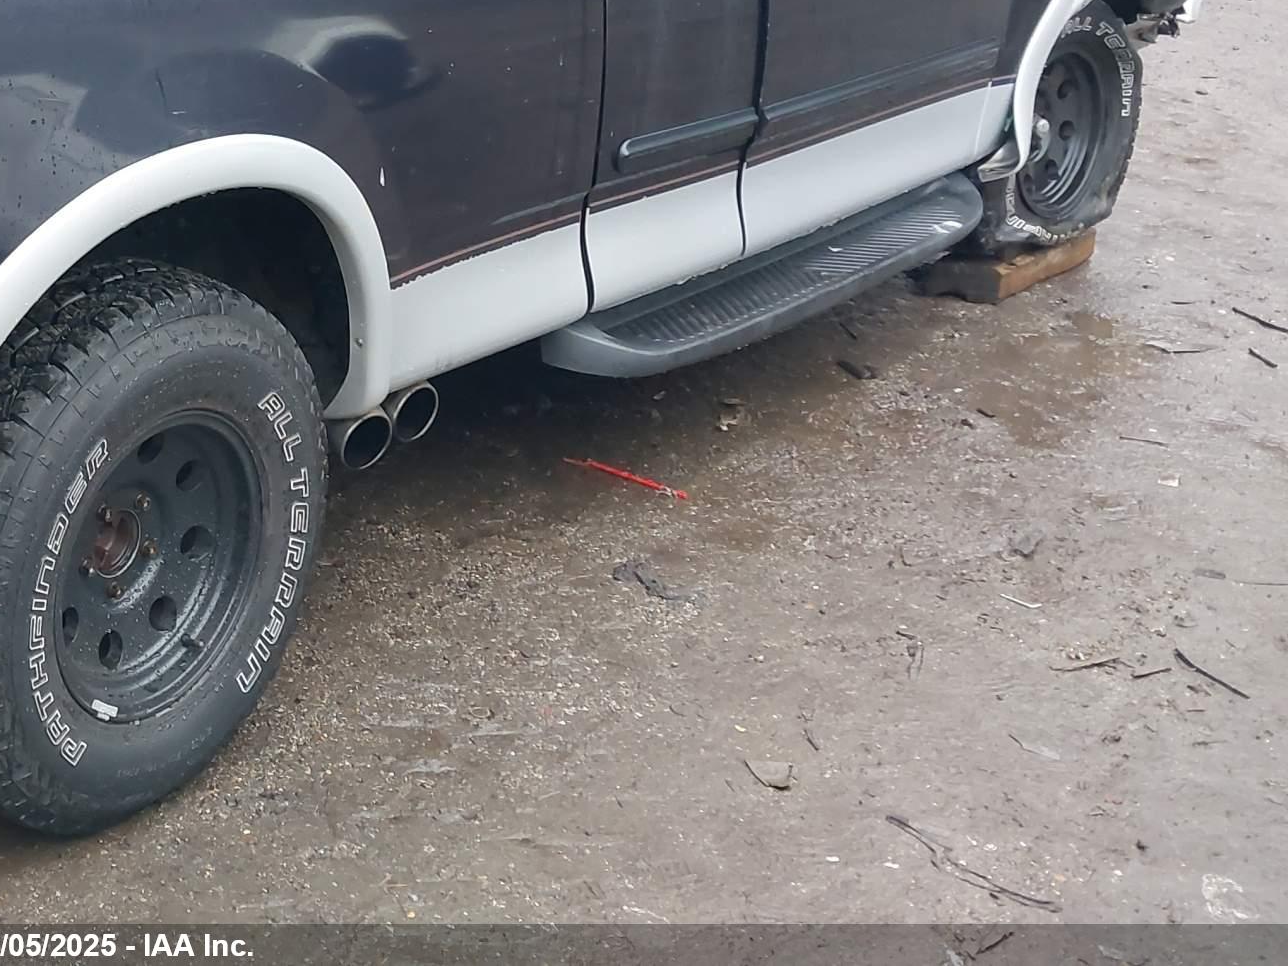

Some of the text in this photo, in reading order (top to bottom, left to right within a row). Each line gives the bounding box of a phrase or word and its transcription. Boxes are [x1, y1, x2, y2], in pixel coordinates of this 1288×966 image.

[29, 439, 109, 766] PATHFINDER
[235, 392, 310, 693] ALL TERRAIN
